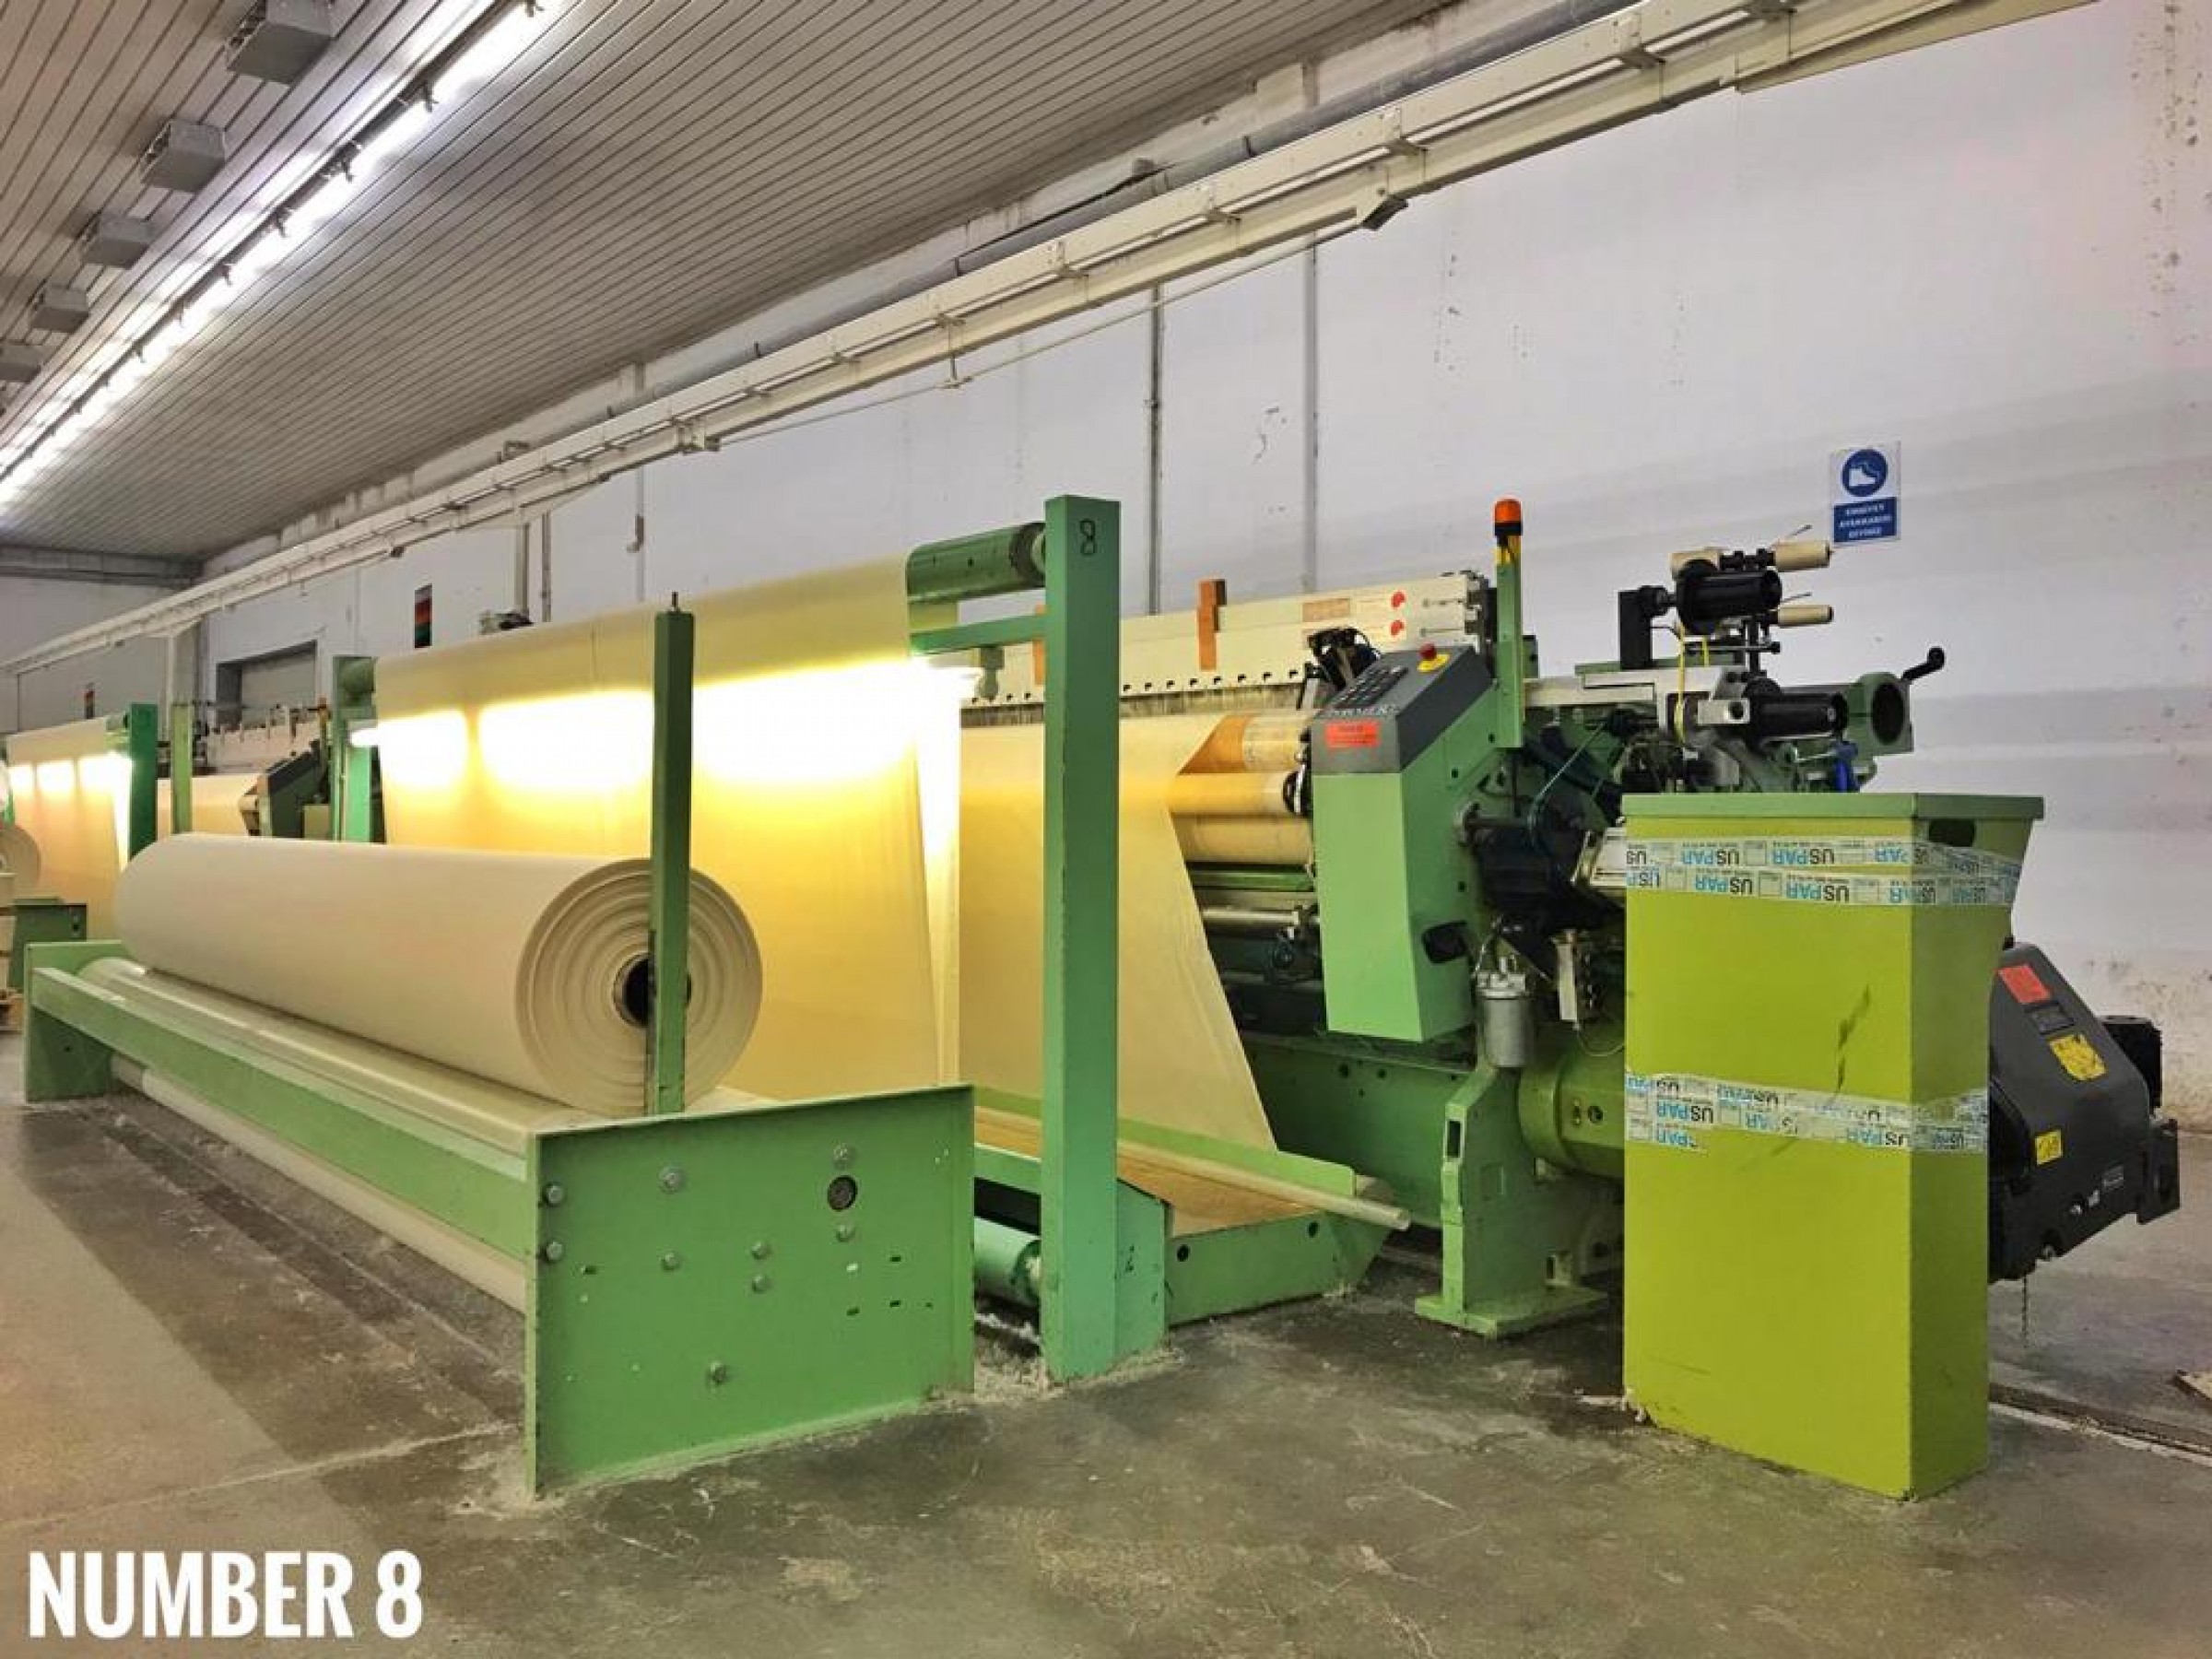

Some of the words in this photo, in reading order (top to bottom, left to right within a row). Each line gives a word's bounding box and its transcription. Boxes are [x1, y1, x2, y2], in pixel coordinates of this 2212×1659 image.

[1079, 518, 1096, 556] 8
[1682, 849, 1741, 865] USPAR
[1772, 848, 1835, 865] USPAR
[1695, 876, 1753, 895] USPAR
[1785, 882, 1850, 903] USPAR
[1656, 1100, 1714, 1124] USPAR
